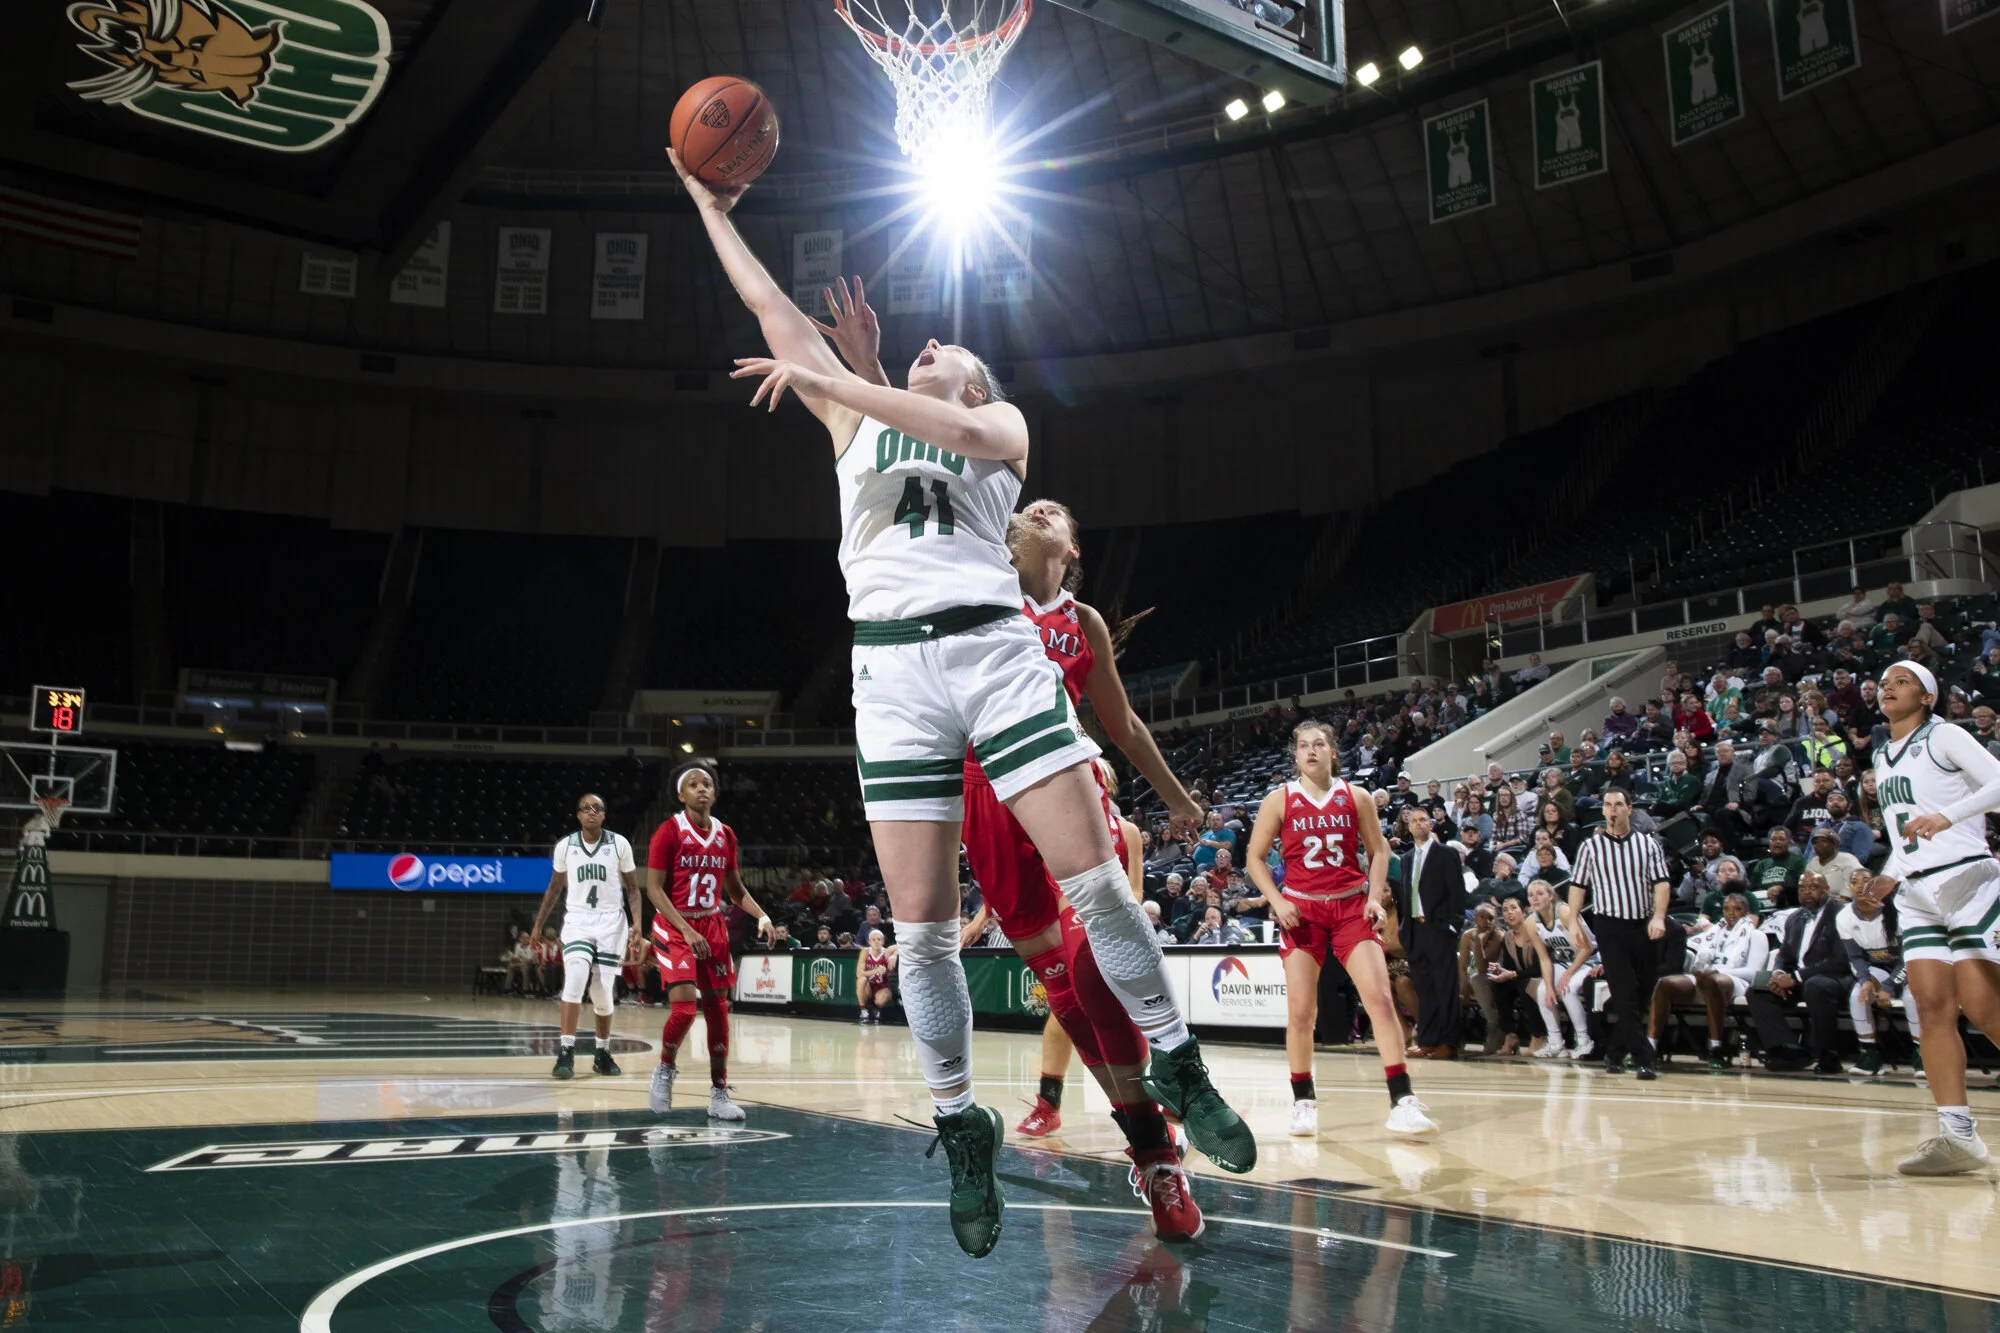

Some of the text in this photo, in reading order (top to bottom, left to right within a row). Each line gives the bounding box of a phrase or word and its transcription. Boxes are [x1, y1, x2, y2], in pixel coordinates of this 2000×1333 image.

[1677, 15, 1719, 43] DANIELS
[1784, 48, 1850, 81] CHAMPION
[1785, 43, 1847, 72] NATIONAL
[1545, 71, 1587, 92] HOUSKA
[1678, 98, 1736, 128] CHAMPION
[1679, 94, 1732, 121] NATIONAL
[1437, 110, 1476, 130] BLOSSER
[1541, 152, 1599, 173] CHAMPION
[1543, 148, 1595, 165] NATIONAL
[510, 232, 540, 249] OHIO
[607, 238, 636, 257] OHIO
[804, 236, 831, 255] OHIO
[894, 476, 955, 539] 41
[1506, 594, 1535, 610] lovin'
[1666, 622, 1727, 641] RESERVED
[52, 706, 74, 730] 18
[1228, 706, 1264, 719] RESERVED
[1292, 814, 1352, 832] MIAMI
[1303, 833, 1344, 869] 25
[680, 855, 727, 870] MIAMI
[428, 860, 504, 888] pepsi
[577, 863, 607, 883] OHIO
[585, 885, 599, 908] 4
[687, 873, 717, 908] 13
[715, 963, 728, 976] M
[755, 975, 776, 992] Wendy's
[1221, 983, 1287, 996] DAVID WHITE
